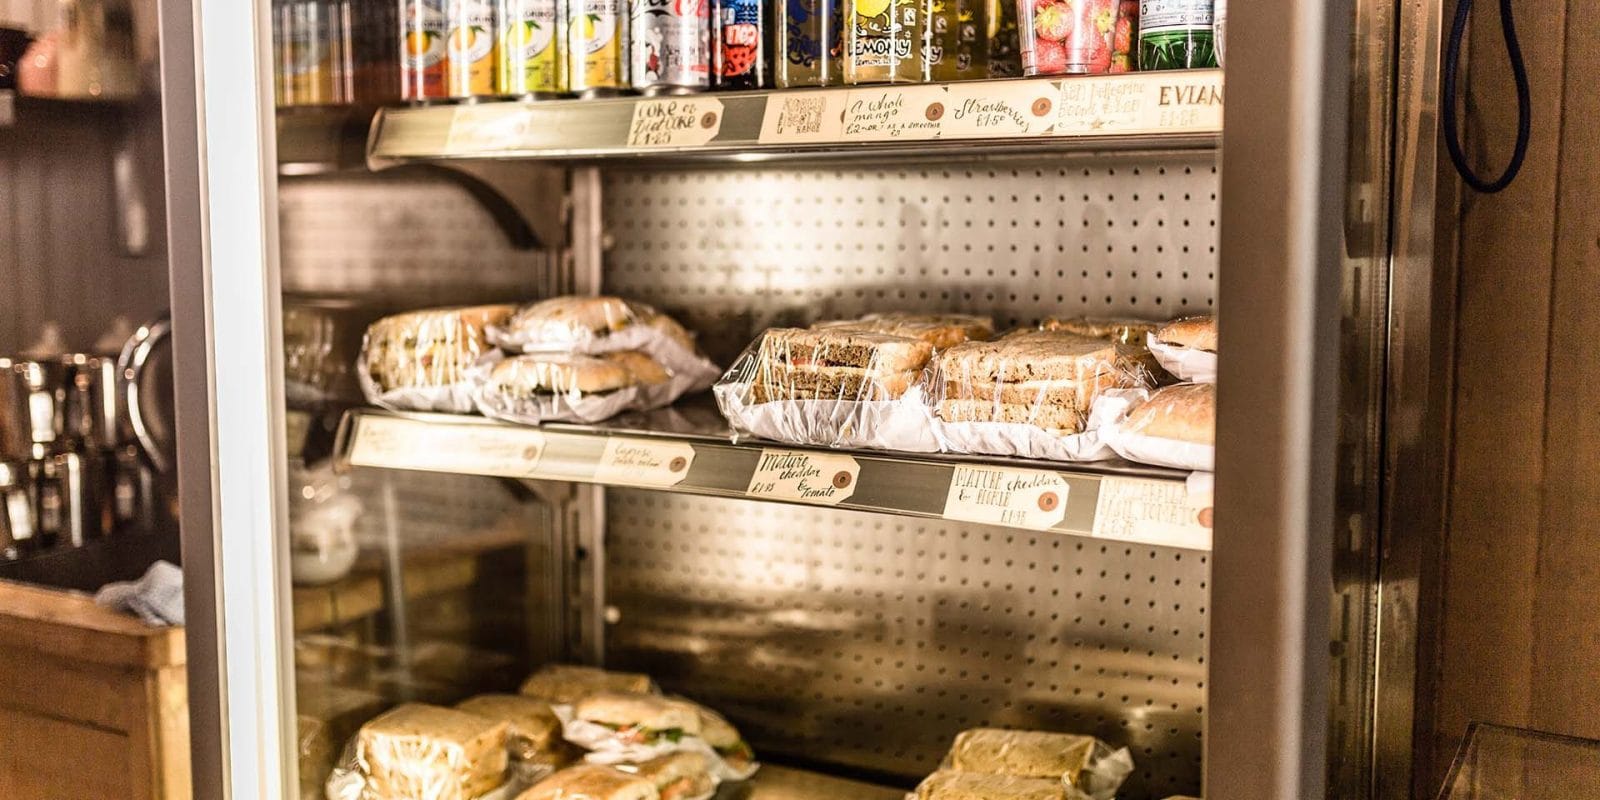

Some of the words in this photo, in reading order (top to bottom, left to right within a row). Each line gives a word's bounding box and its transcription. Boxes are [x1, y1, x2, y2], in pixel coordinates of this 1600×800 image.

[1158, 85, 1224, 106] EVIAN
[854, 109, 898, 124] mango
[760, 452, 808, 471] Mature
[780, 465, 821, 480] cheddar
[1007, 474, 1061, 491] cheddar
